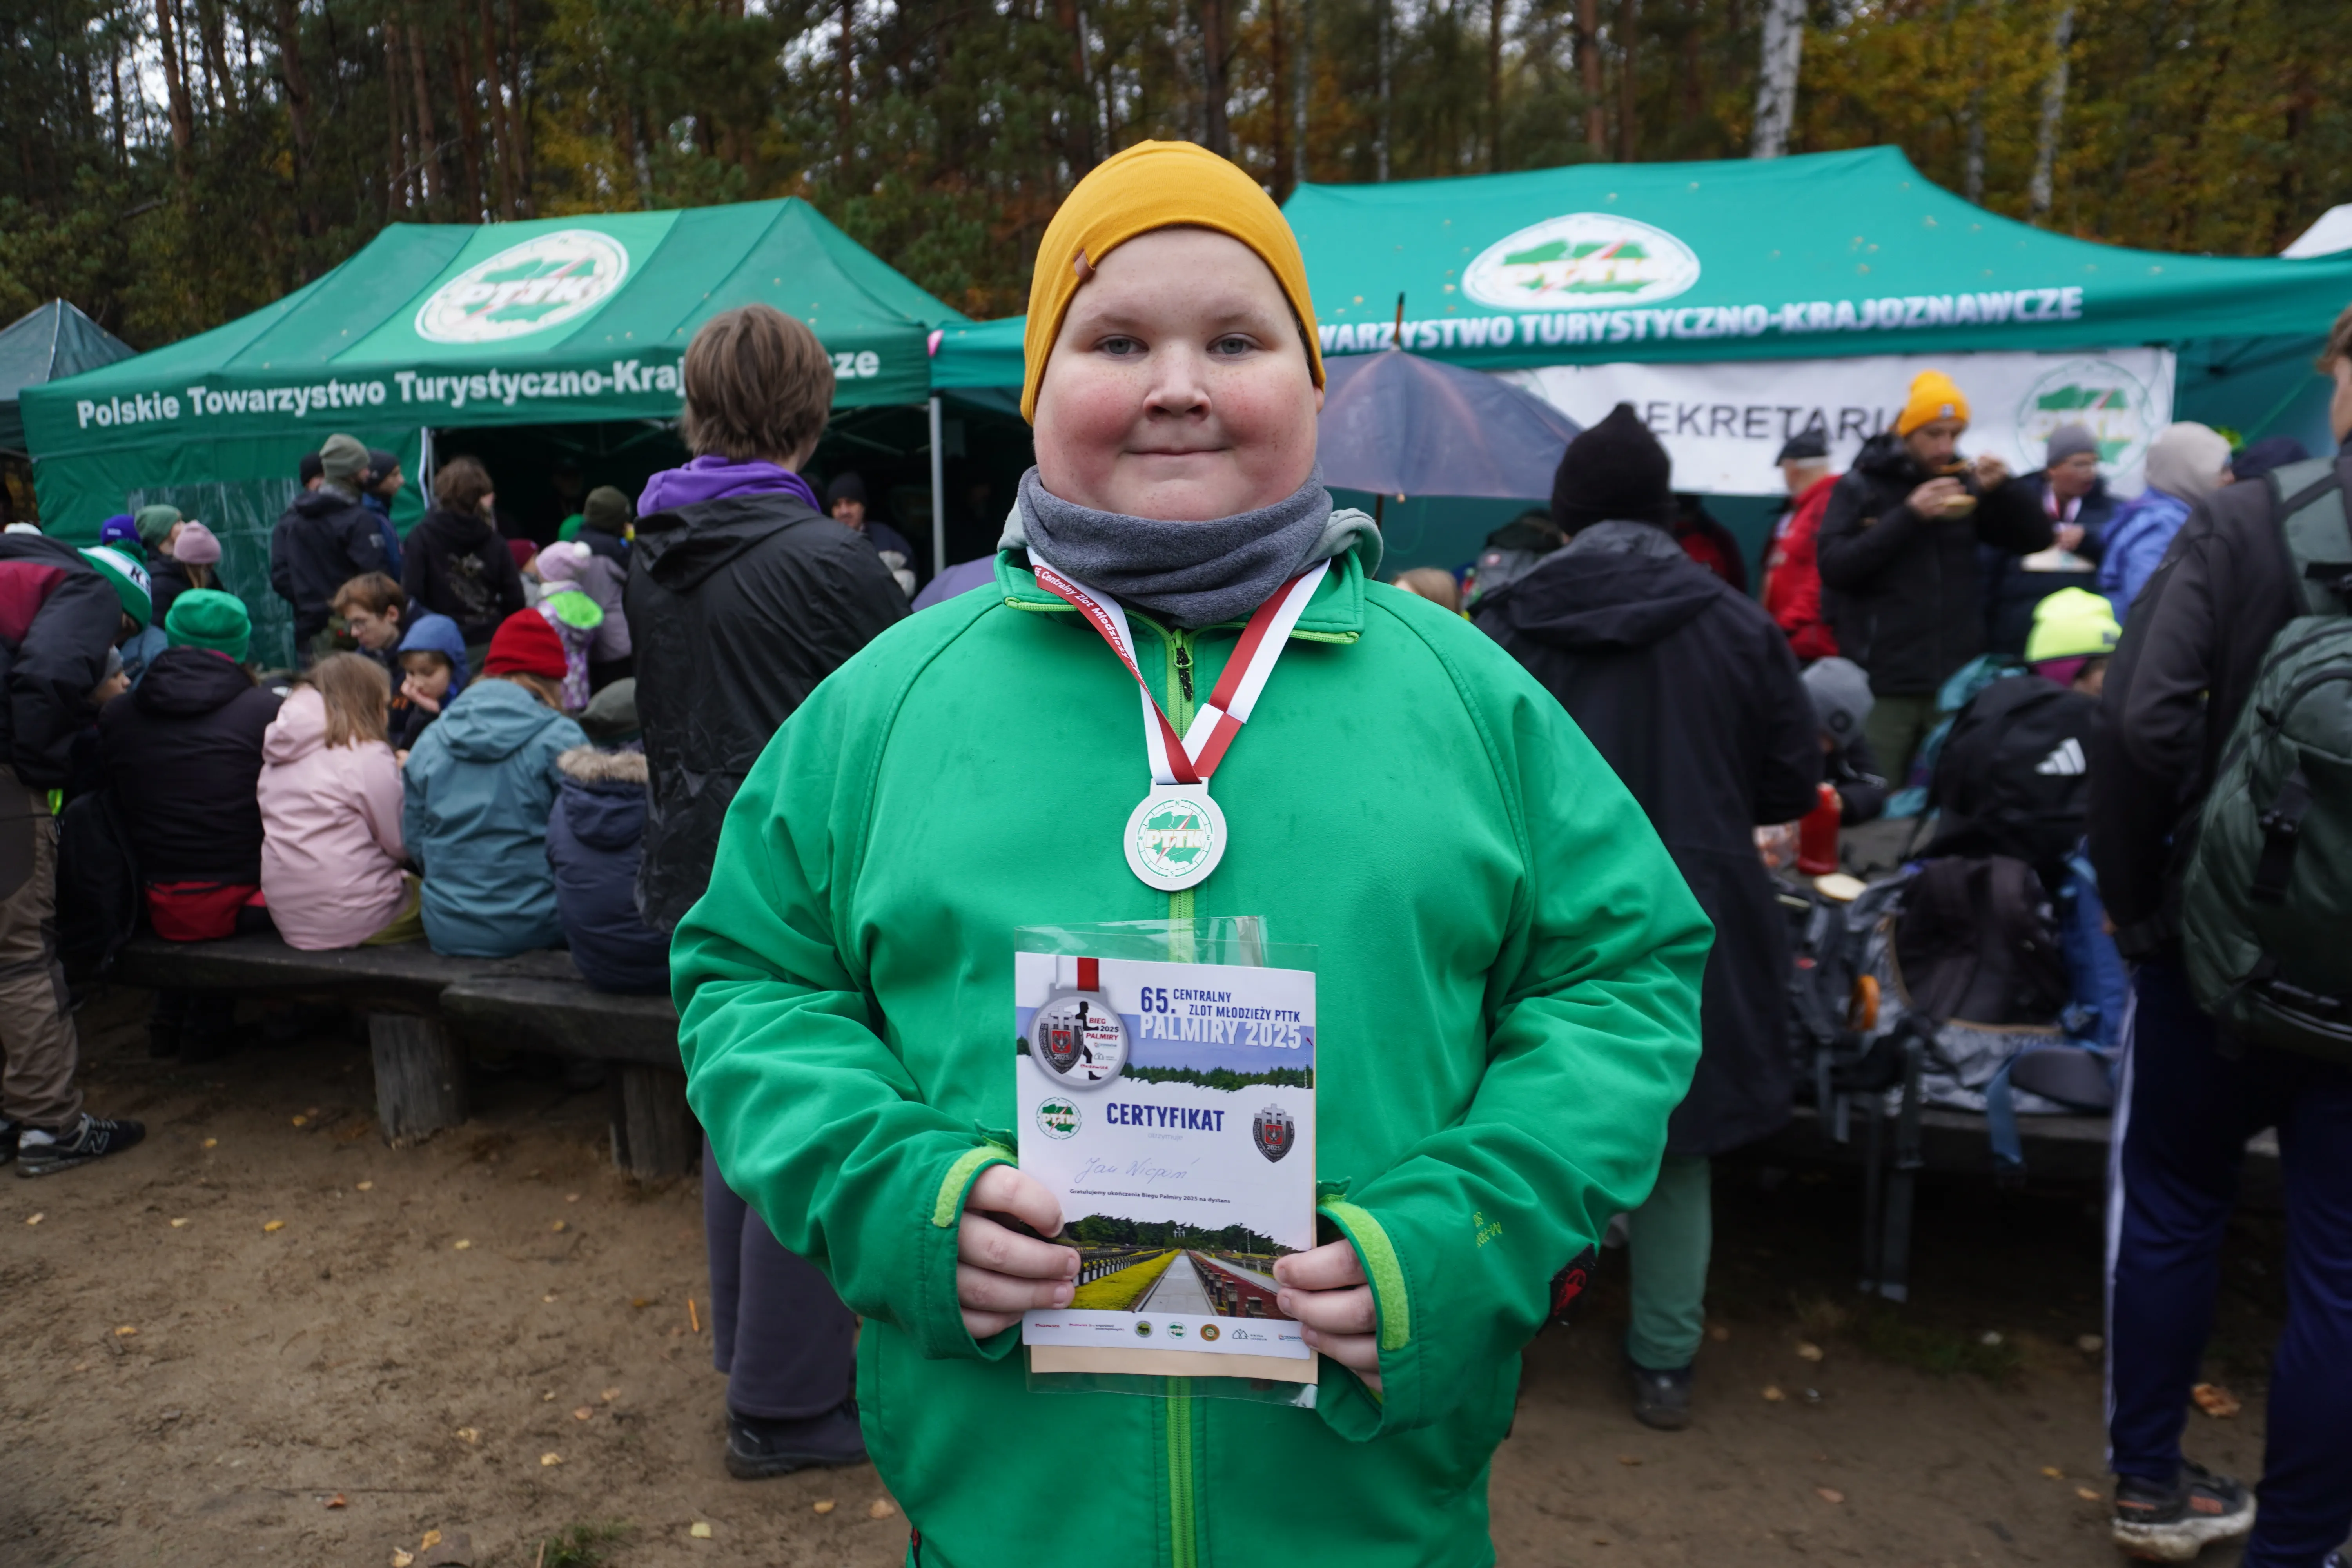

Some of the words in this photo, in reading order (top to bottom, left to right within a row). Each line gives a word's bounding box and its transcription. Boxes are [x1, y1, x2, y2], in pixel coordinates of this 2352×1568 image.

[1317, 316, 1514, 352] WARZYSTWO
[1518, 286, 2083, 344] TURYSTYCZNO-KRAJOZNAWCZE
[77, 391, 180, 428] Polskie
[187, 378, 387, 418] Towarzystwo
[1041, 571, 1077, 595] Centralny
[1074, 593, 1095, 607] Zlot
[1145, 829, 1203, 848] PTTK
[1141, 986, 1176, 1014] 65.
[1173, 988, 1232, 1003] CENTRALNY
[1189, 1004, 1212, 1016] ZLOT
[1216, 1005, 1271, 1020] MŁODZIEŻY
[1275, 1009, 1301, 1022] PTTK
[1086, 1033, 1119, 1041] PALMIRY
[1140, 1014, 1240, 1045] PALMIRY
[1245, 1022, 1302, 1050] 2025
[1041, 1113, 1076, 1125] PTTK
[1107, 1103, 1225, 1132] CERTYFIKAT
